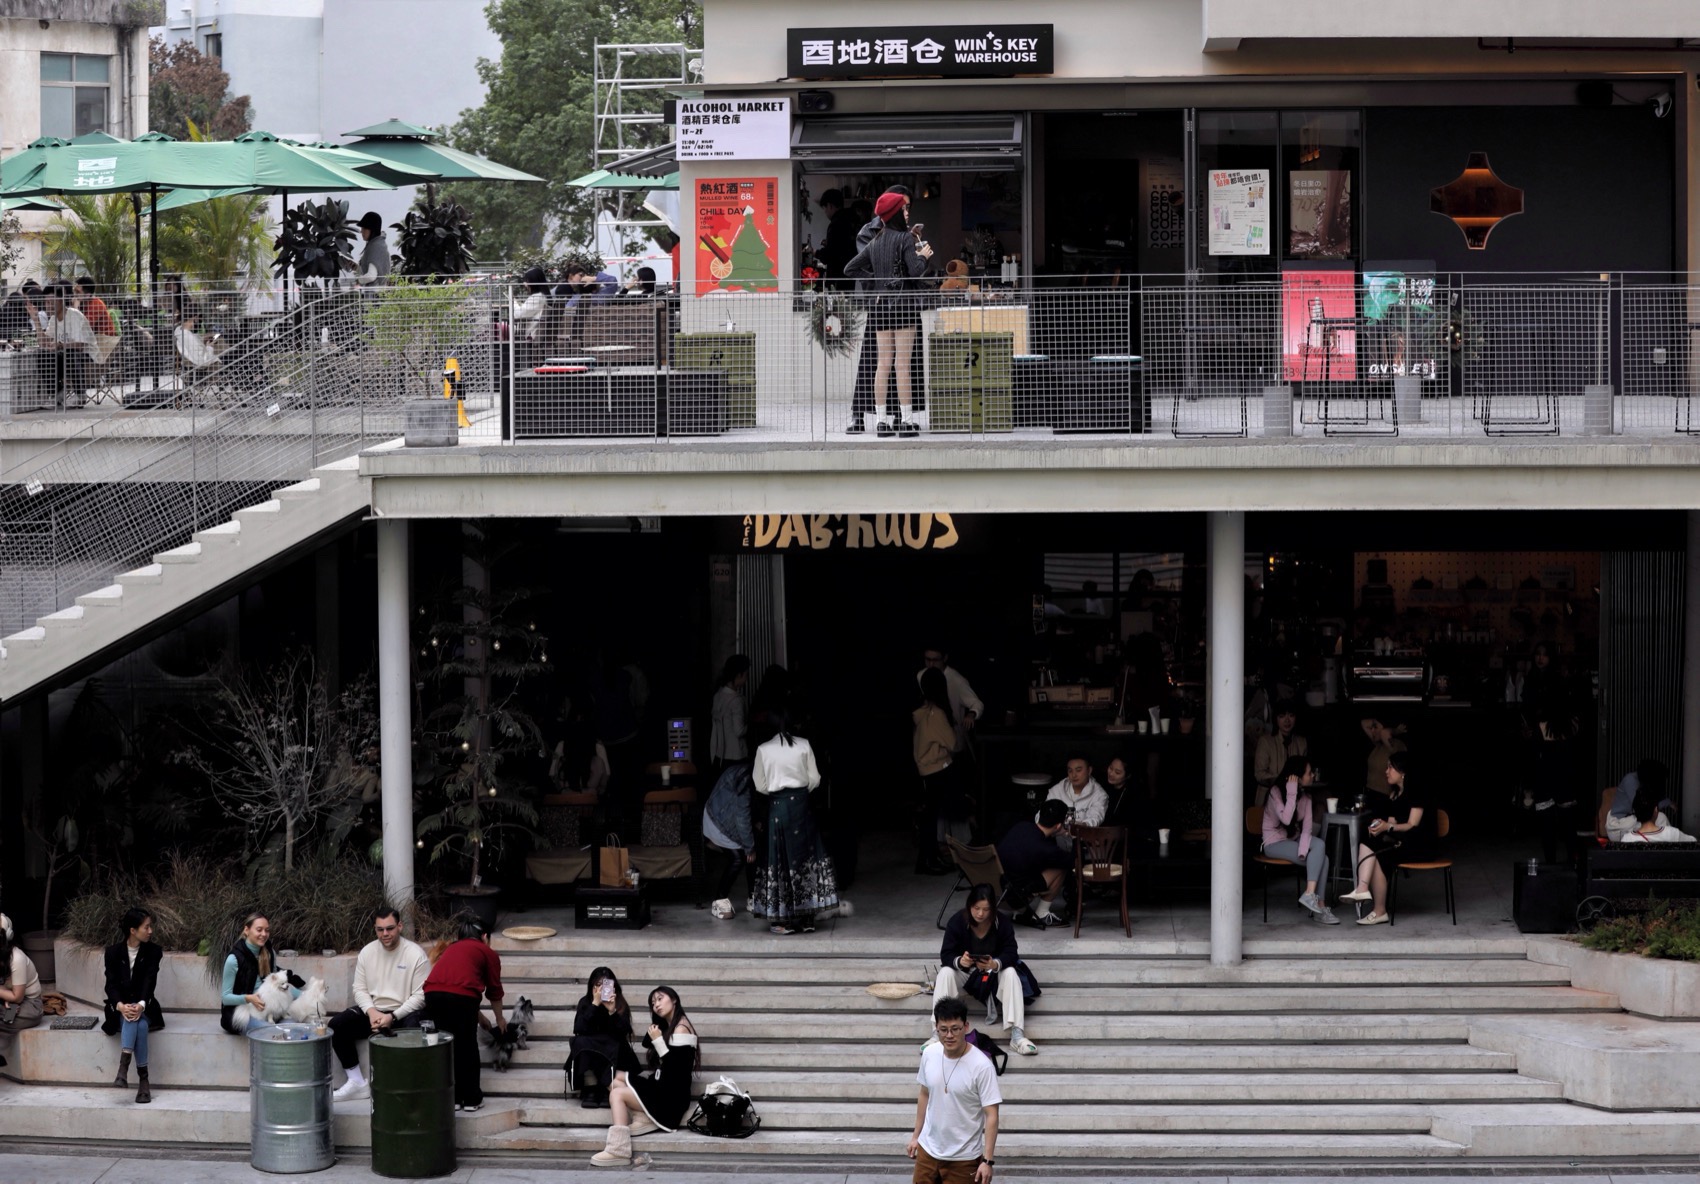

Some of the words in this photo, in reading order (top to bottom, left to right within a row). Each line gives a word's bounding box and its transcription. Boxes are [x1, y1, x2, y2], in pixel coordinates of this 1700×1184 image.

[1008, 38, 1038, 51] KEY
[954, 52, 1037, 63] WAREHOUSE
[681, 103, 734, 113] ALCOHOL
[737, 102, 785, 112] MARKET
[681, 114, 741, 125] 酒精百货仓库
[700, 182, 738, 194] 熱紅酒
[700, 208, 725, 216] CHILL
[727, 207, 746, 215] DAY
[1391, 363, 1422, 375] SAE
